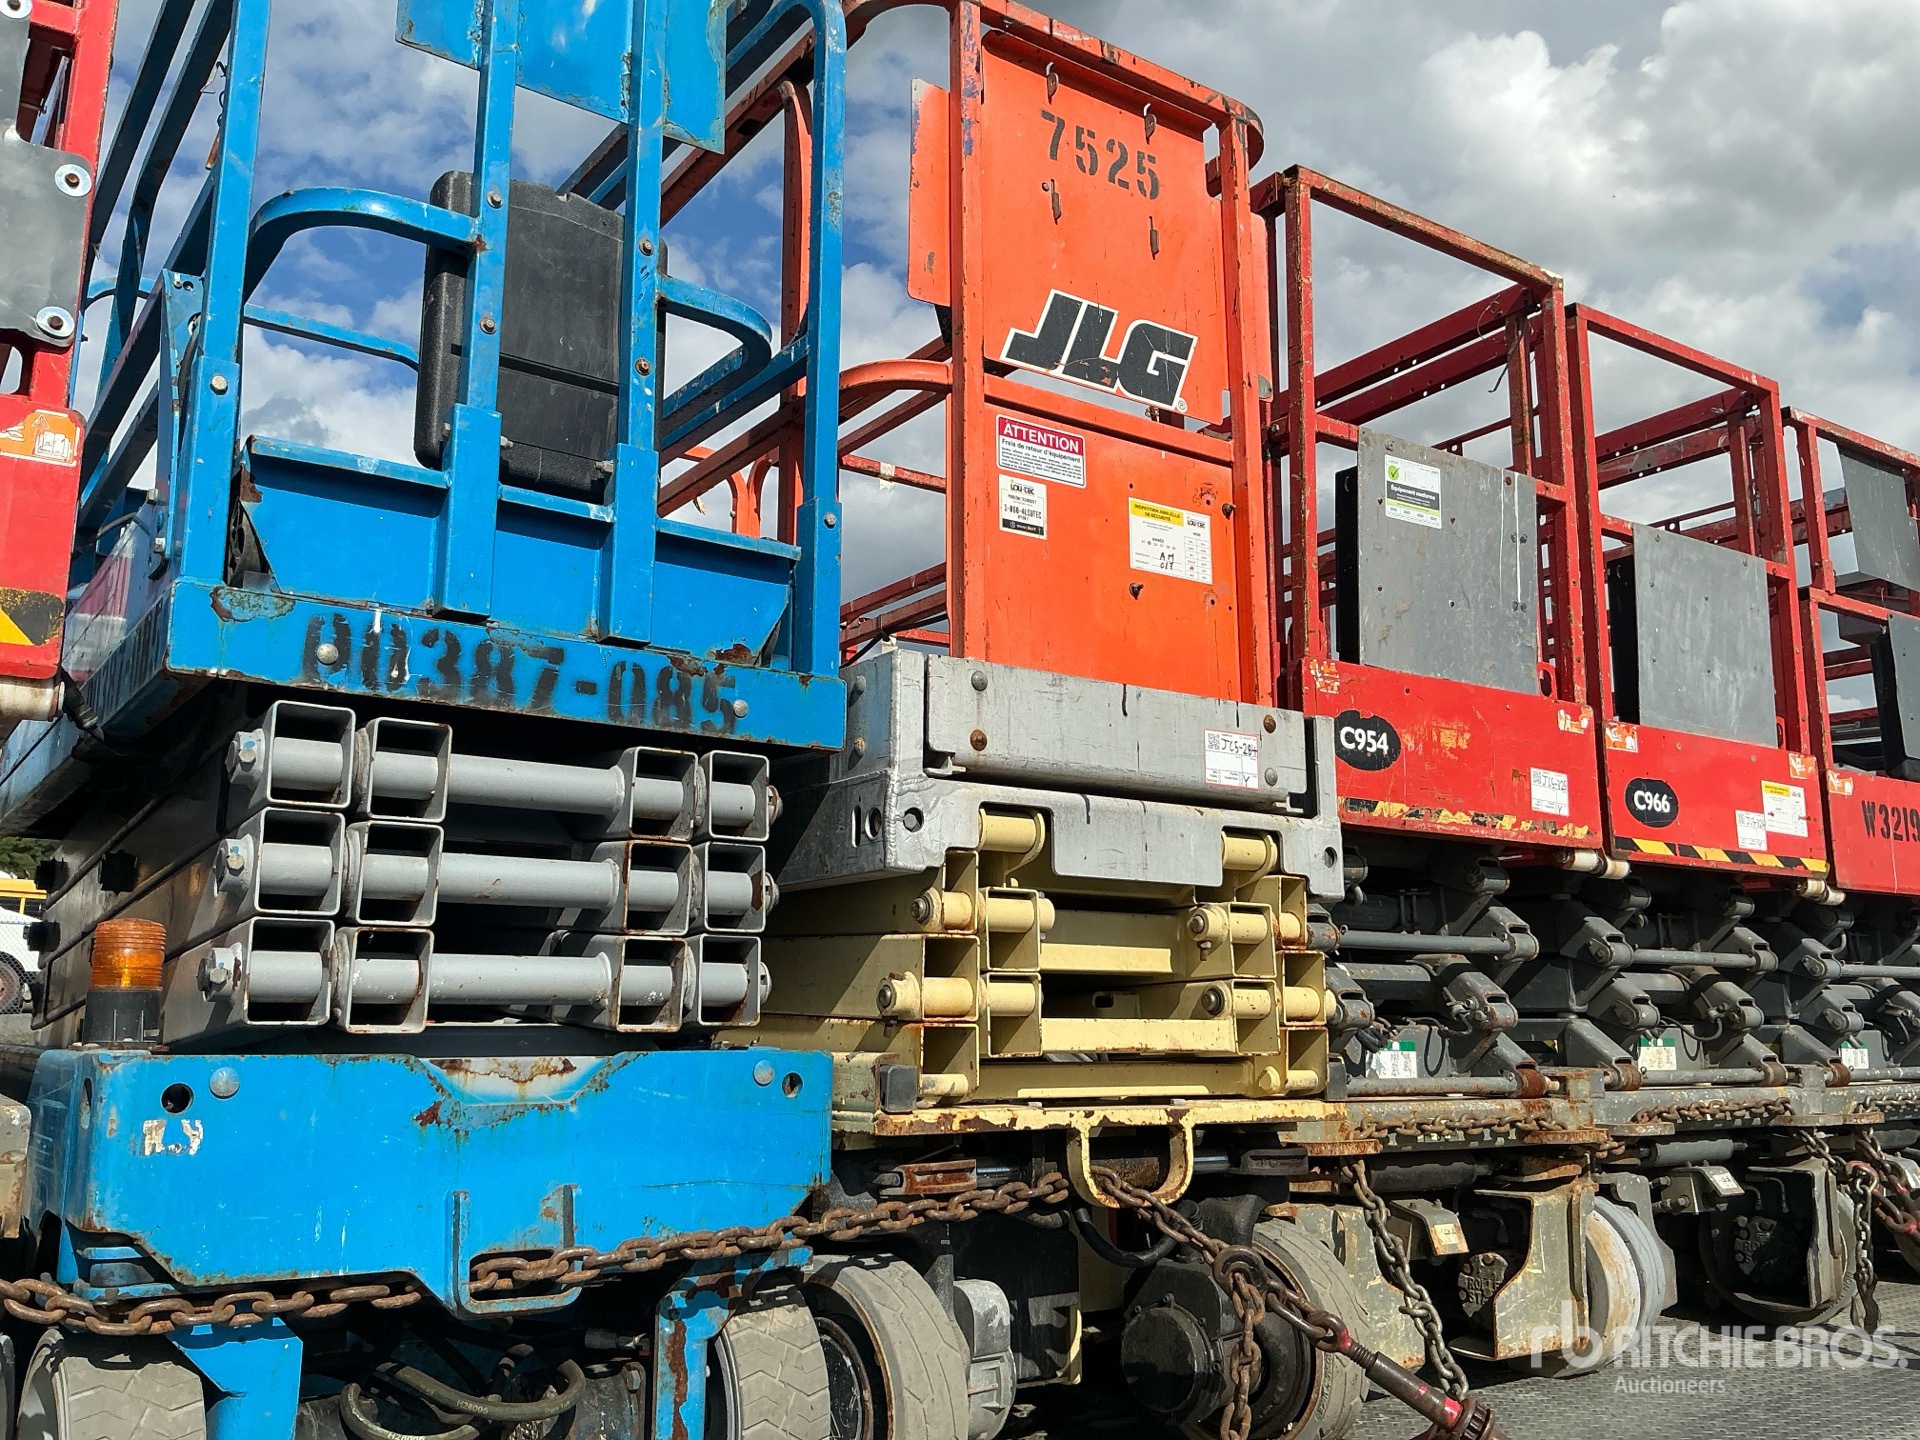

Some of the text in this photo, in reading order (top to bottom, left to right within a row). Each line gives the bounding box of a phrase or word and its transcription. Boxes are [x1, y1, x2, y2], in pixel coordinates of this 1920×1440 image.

[1040, 108, 1160, 201] 7525
[999, 288, 1198, 410] JLG
[1001, 438, 1016, 448] Frais
[1025, 446, 1043, 454] retour
[1003, 422, 1079, 454] ATTENTION
[1339, 725, 1389, 755] C954
[1633, 789, 1671, 814] C966
